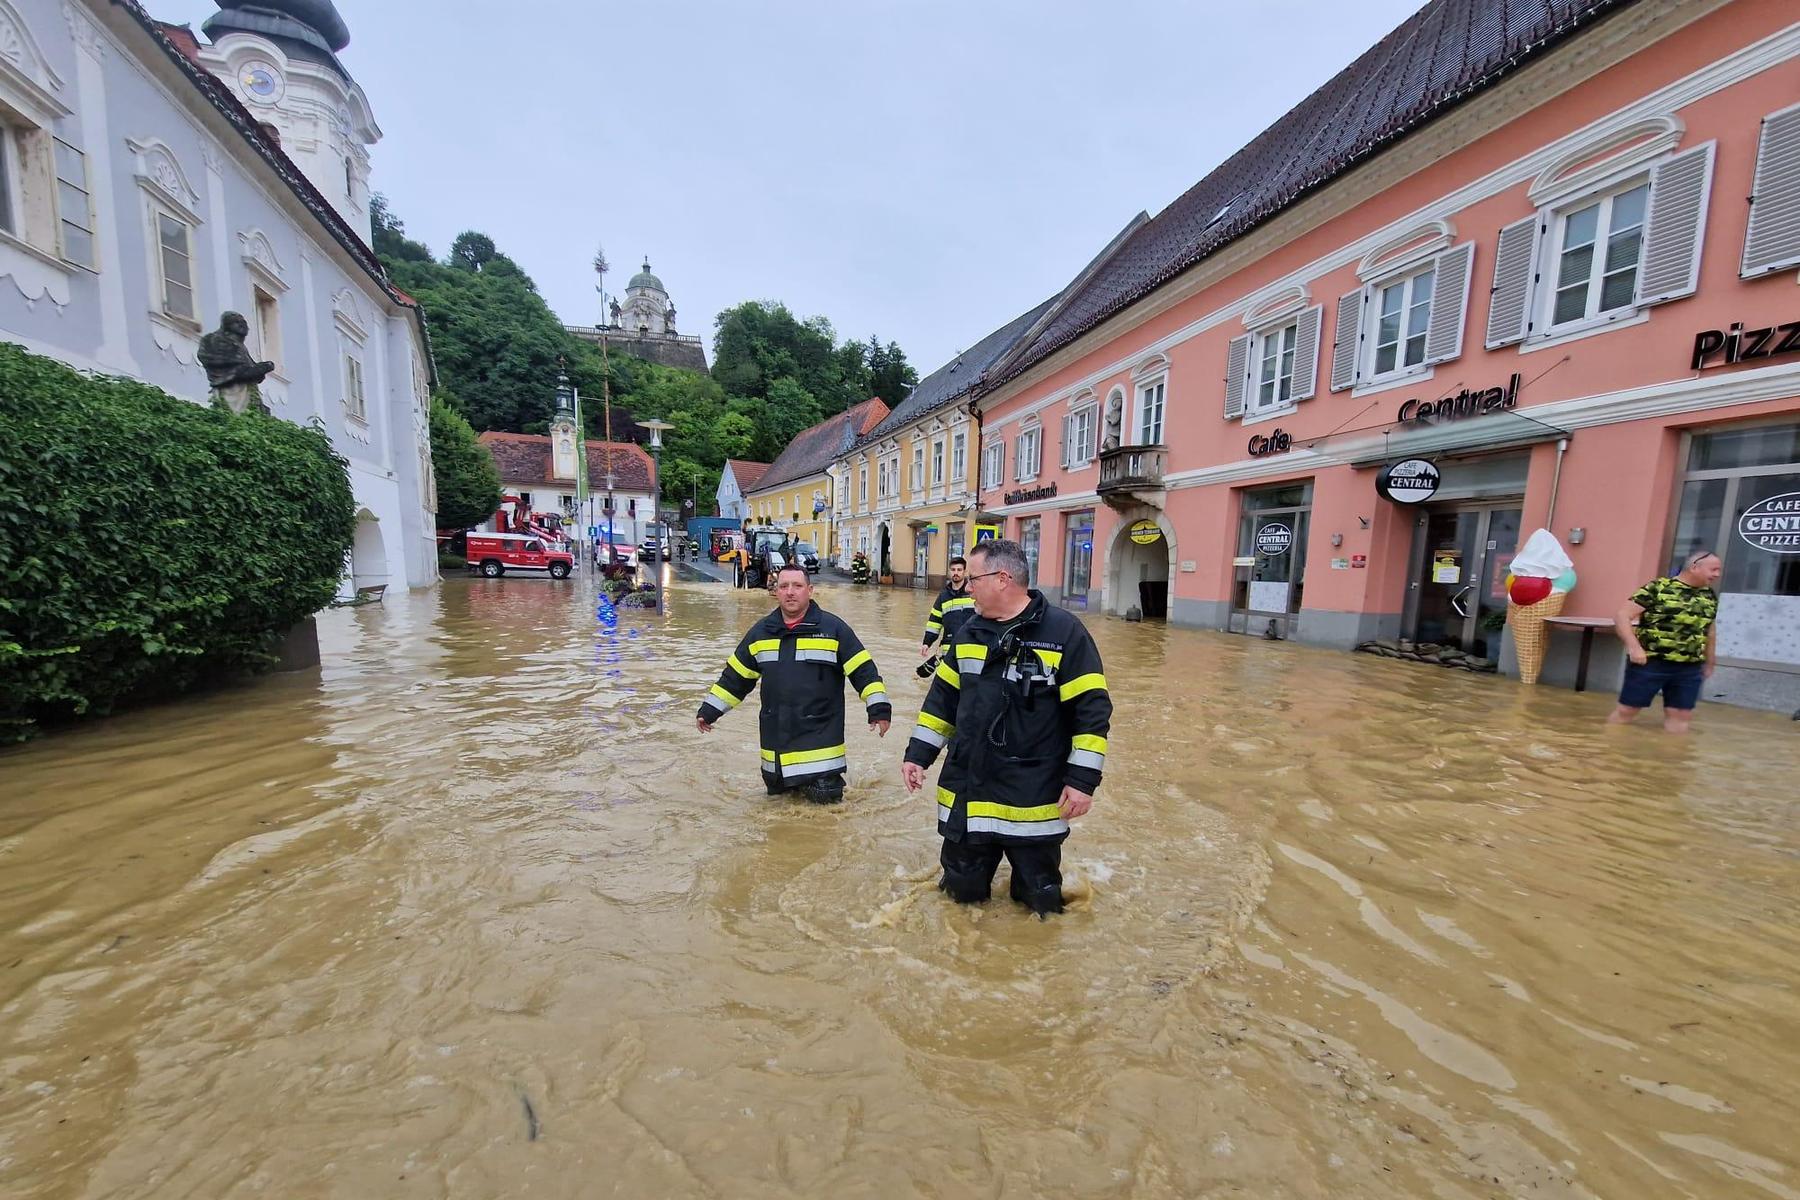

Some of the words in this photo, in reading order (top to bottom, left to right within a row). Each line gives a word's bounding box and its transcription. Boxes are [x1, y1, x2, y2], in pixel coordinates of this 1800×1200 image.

[1690, 321, 1800, 370] Pizz
[1398, 372, 1520, 423] Central
[1391, 477, 1434, 488] CENTRAL
[1766, 500, 1800, 511] CAFE
[1259, 535, 1289, 544] CENTRAL
